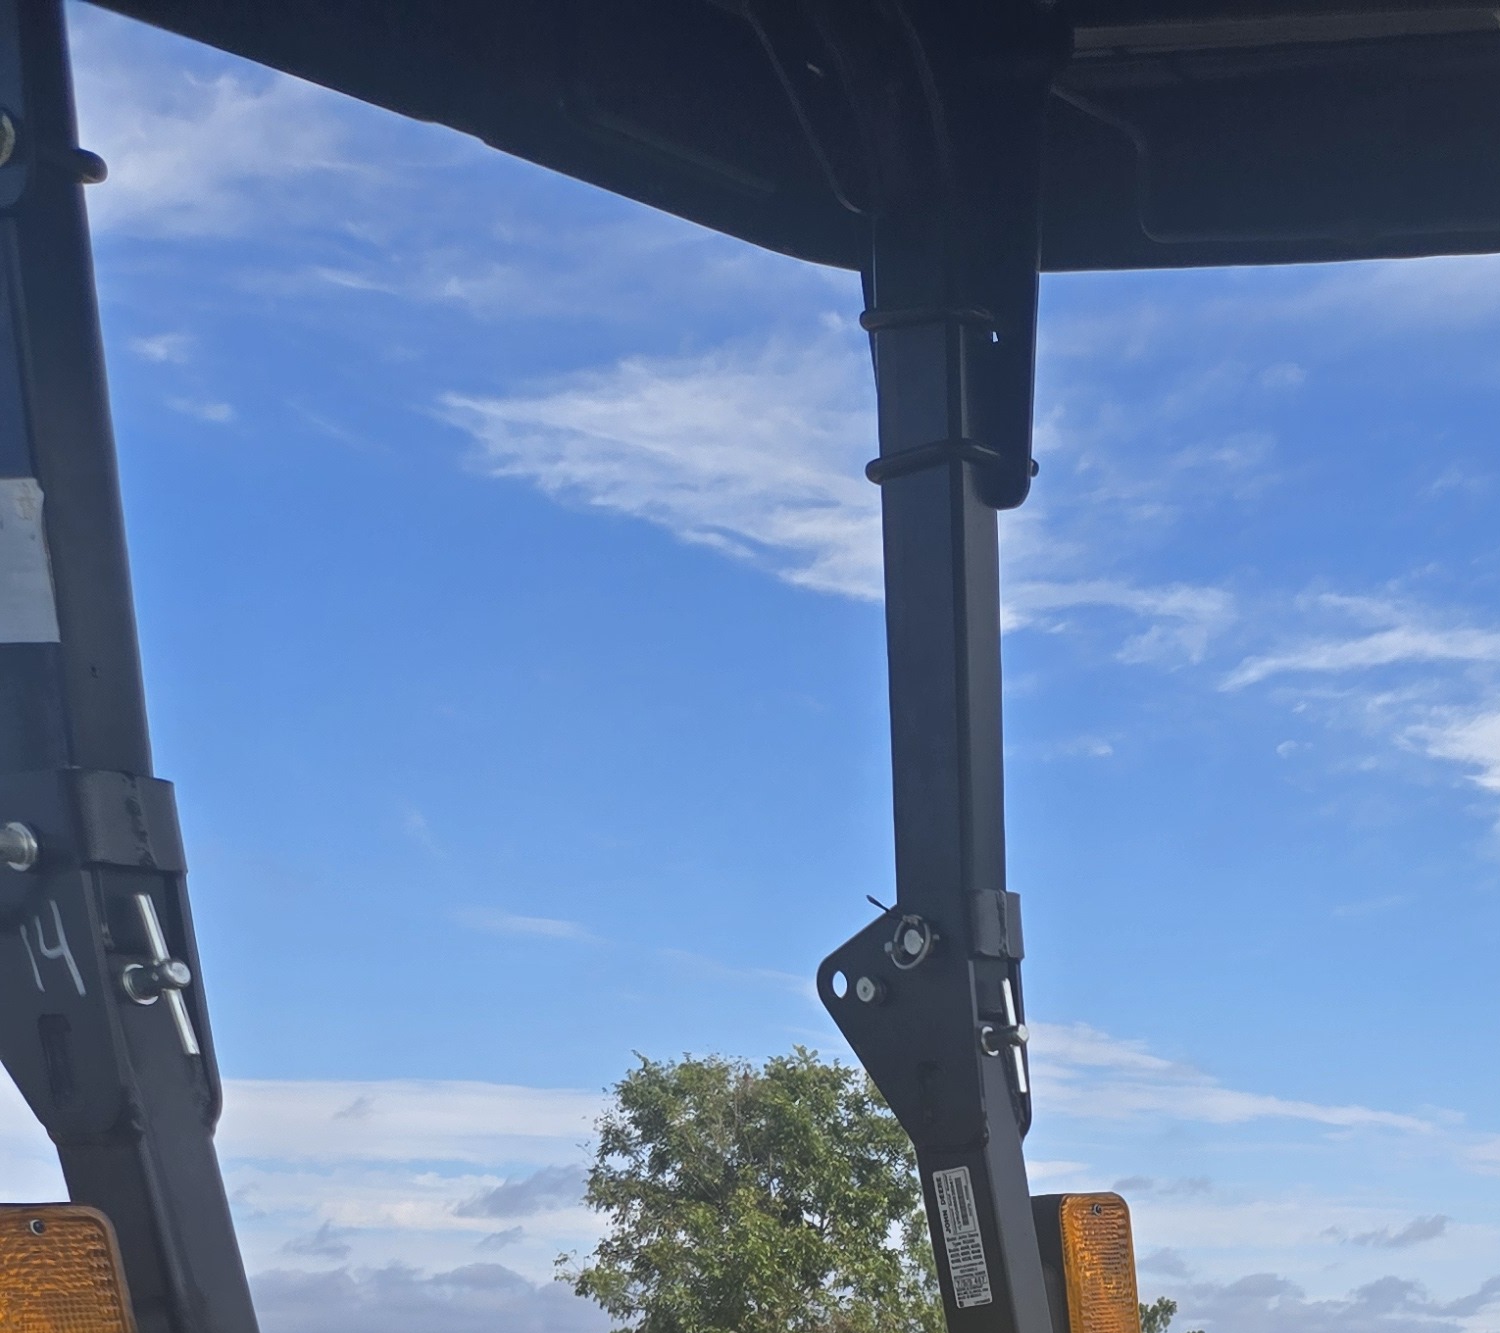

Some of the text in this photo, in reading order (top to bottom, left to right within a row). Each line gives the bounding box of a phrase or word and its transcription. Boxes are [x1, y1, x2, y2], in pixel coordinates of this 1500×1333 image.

[20, 899, 87, 998] 14
[935, 1176, 952, 1234] JOHN DEERE
